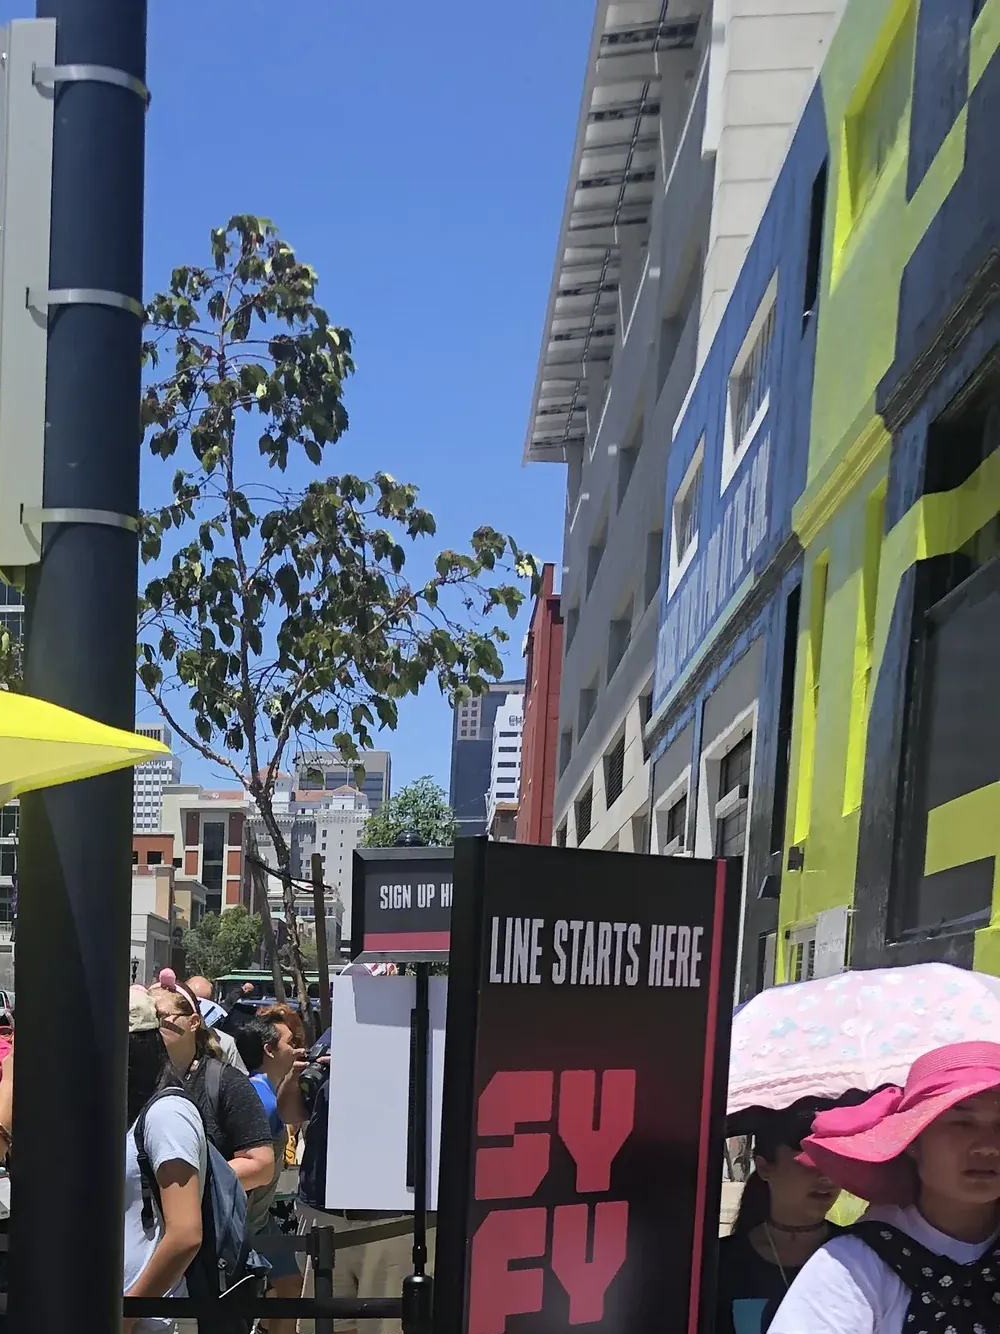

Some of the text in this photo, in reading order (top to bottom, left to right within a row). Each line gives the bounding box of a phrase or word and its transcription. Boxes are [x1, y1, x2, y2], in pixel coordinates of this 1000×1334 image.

[380, 884, 412, 909] SIGN
[417, 883, 436, 908] UP
[489, 916, 704, 988] LINE STARTS HERE
[474, 1069, 636, 1200] SY
